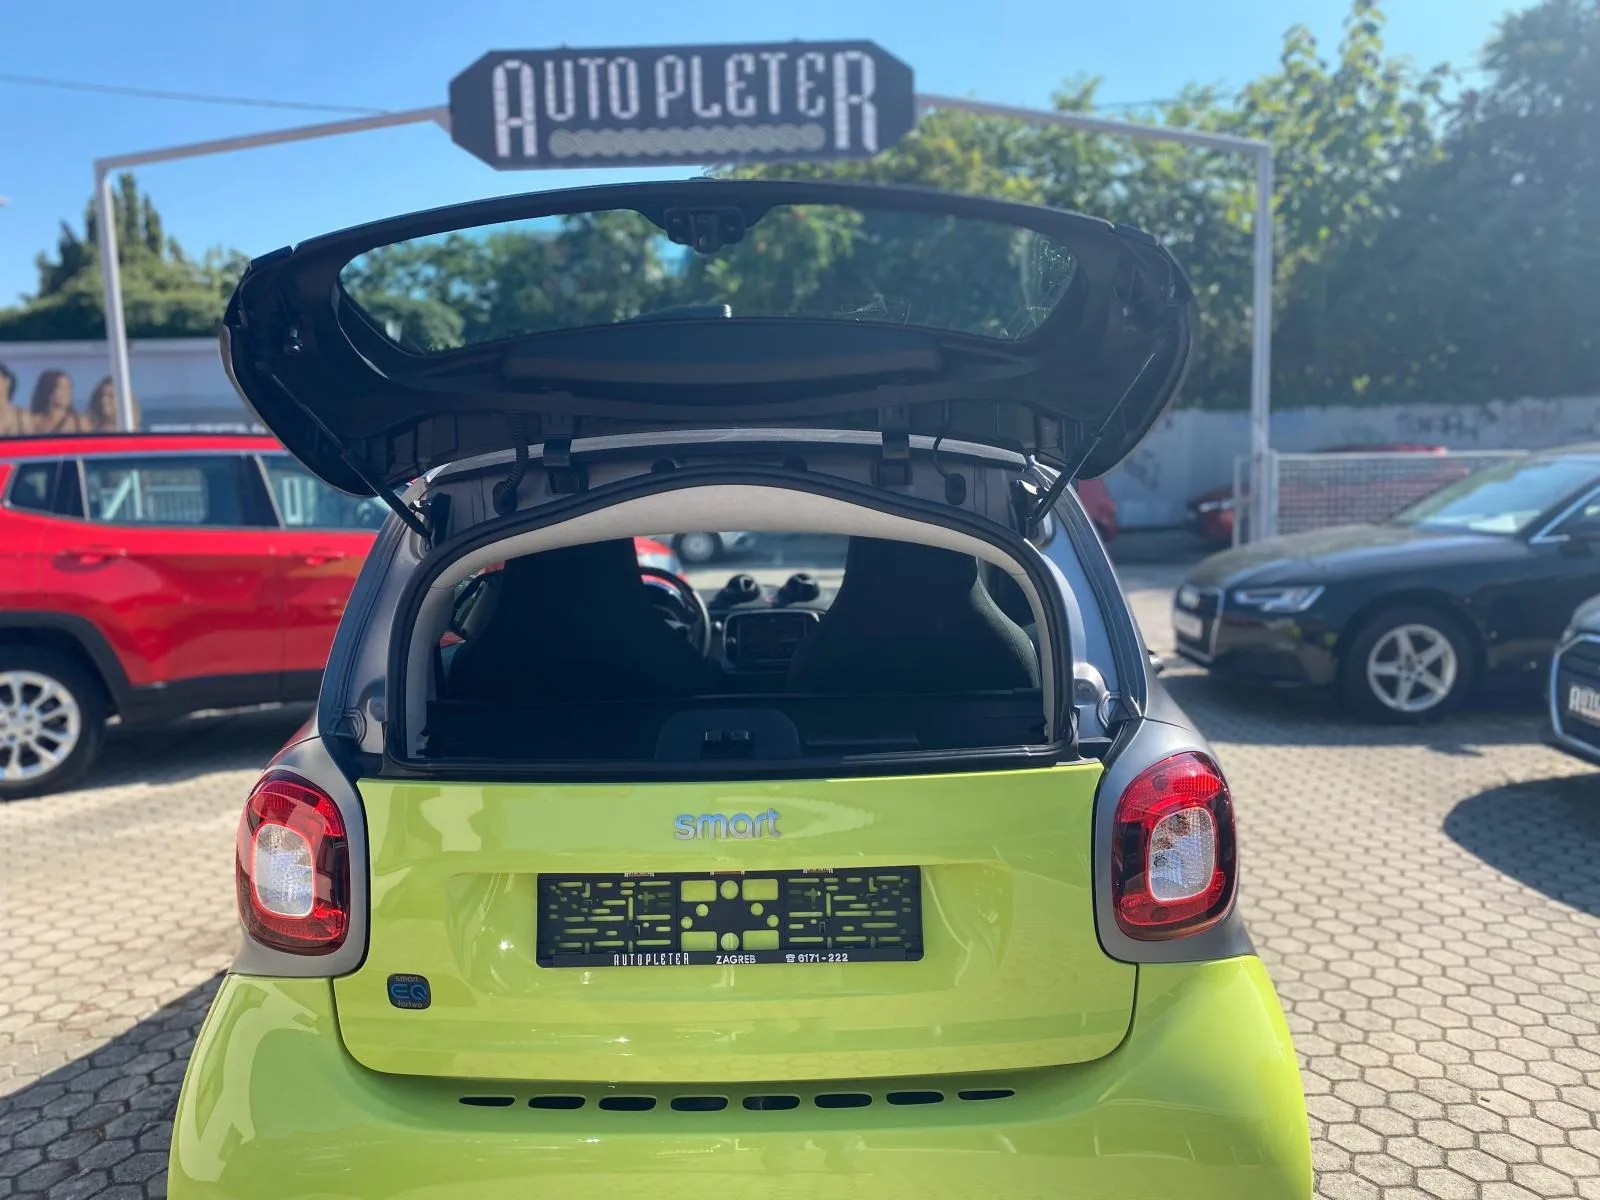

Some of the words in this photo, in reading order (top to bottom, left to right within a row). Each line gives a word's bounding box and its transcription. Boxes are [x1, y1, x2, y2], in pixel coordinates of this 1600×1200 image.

[674, 808, 781, 840] smart
[613, 952, 689, 966] AUTOPLETER
[716, 954, 756, 965] ZAGREB
[391, 983, 427, 1000] EQ
